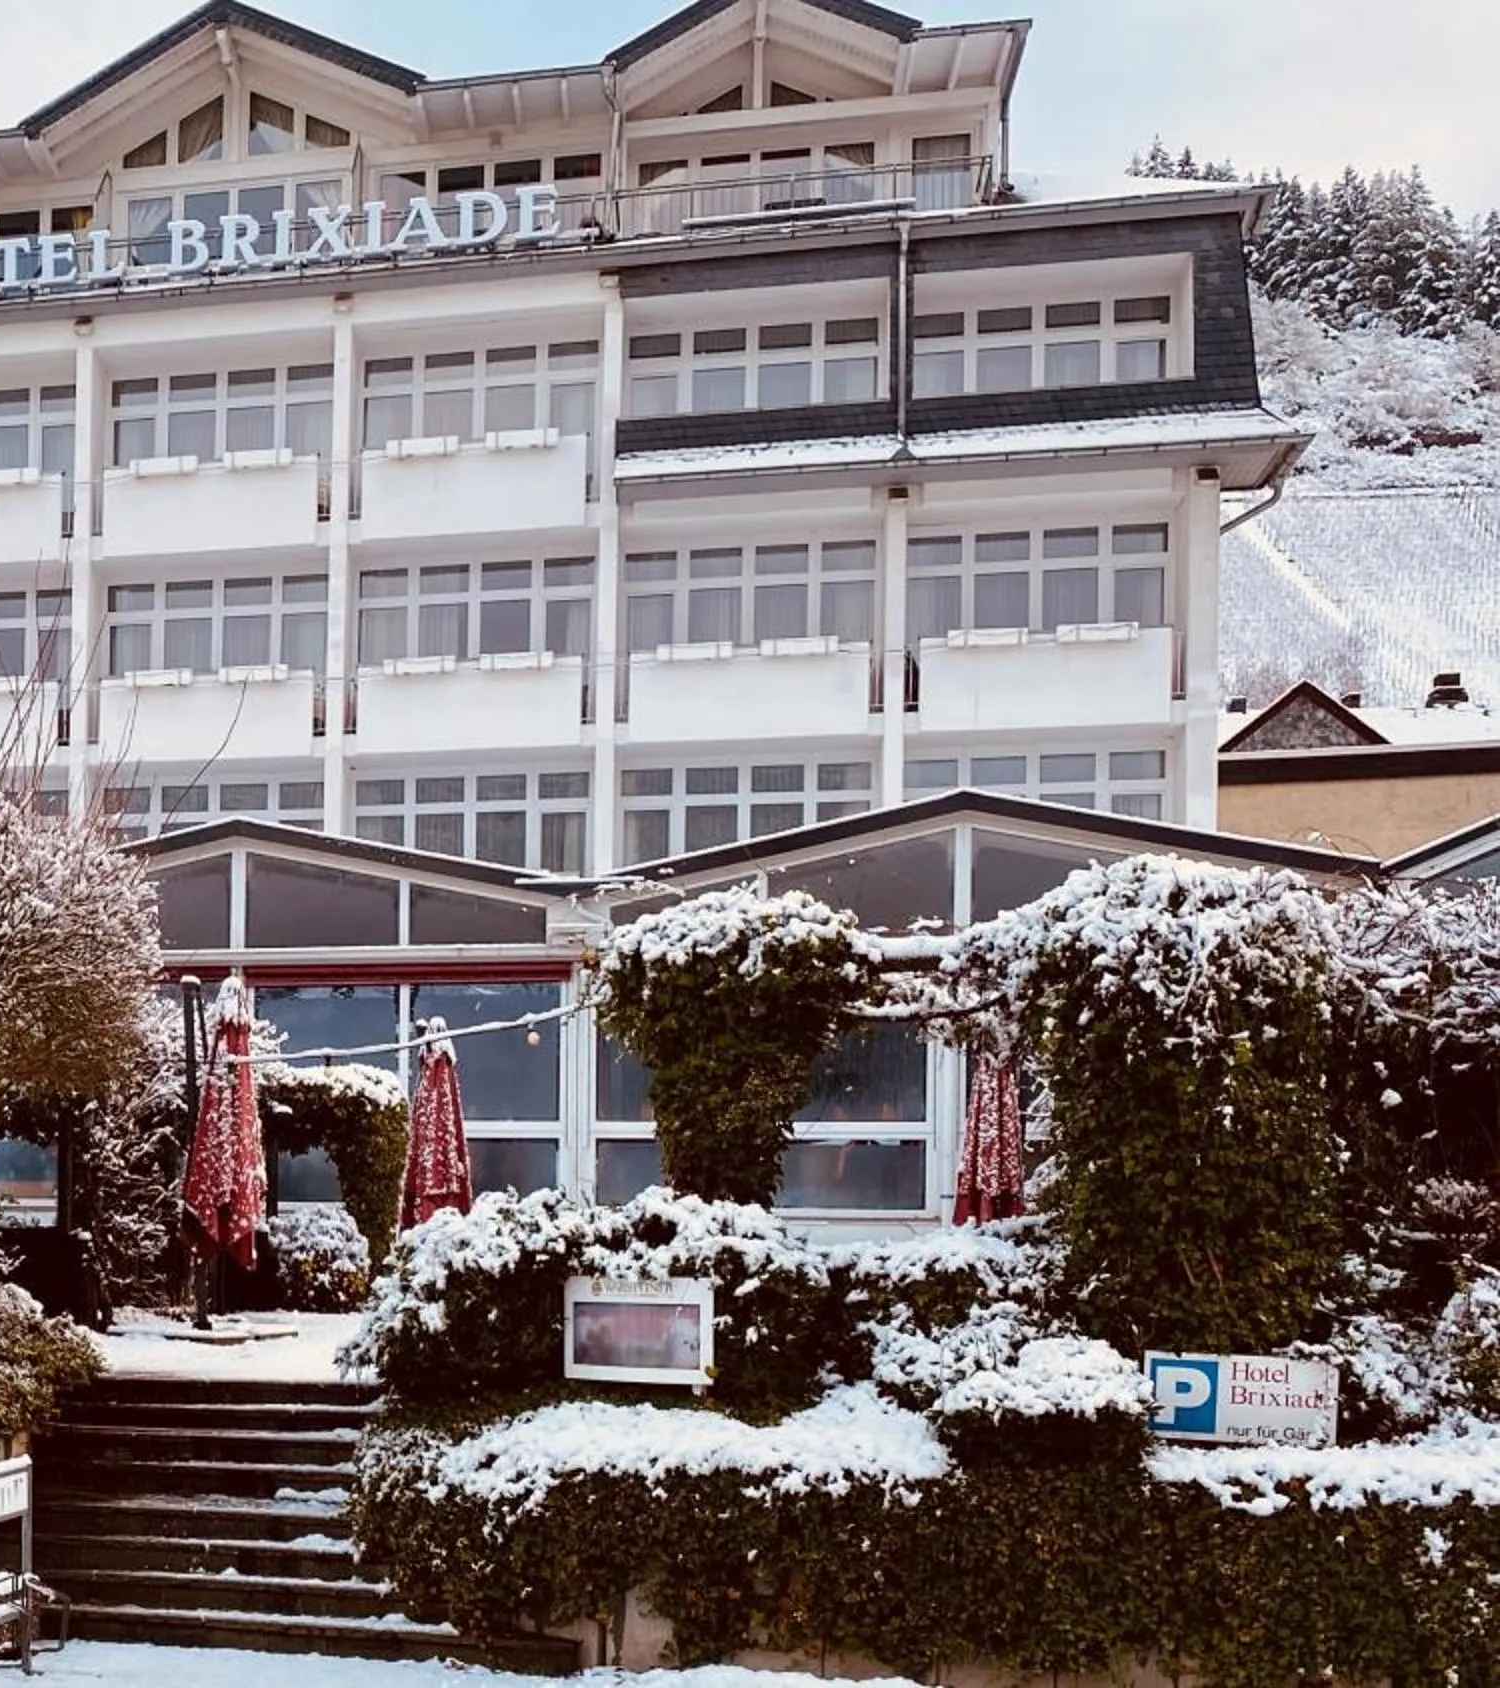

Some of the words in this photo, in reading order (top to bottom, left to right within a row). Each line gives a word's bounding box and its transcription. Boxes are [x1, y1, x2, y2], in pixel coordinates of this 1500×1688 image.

[167, 184, 563, 273] BRIXIADE
[1231, 1361, 1290, 1384] Hotel
[1230, 1385, 1323, 1409] Brixiad
[1227, 1426, 1253, 1437] nur
[1257, 1424, 1279, 1439] für
